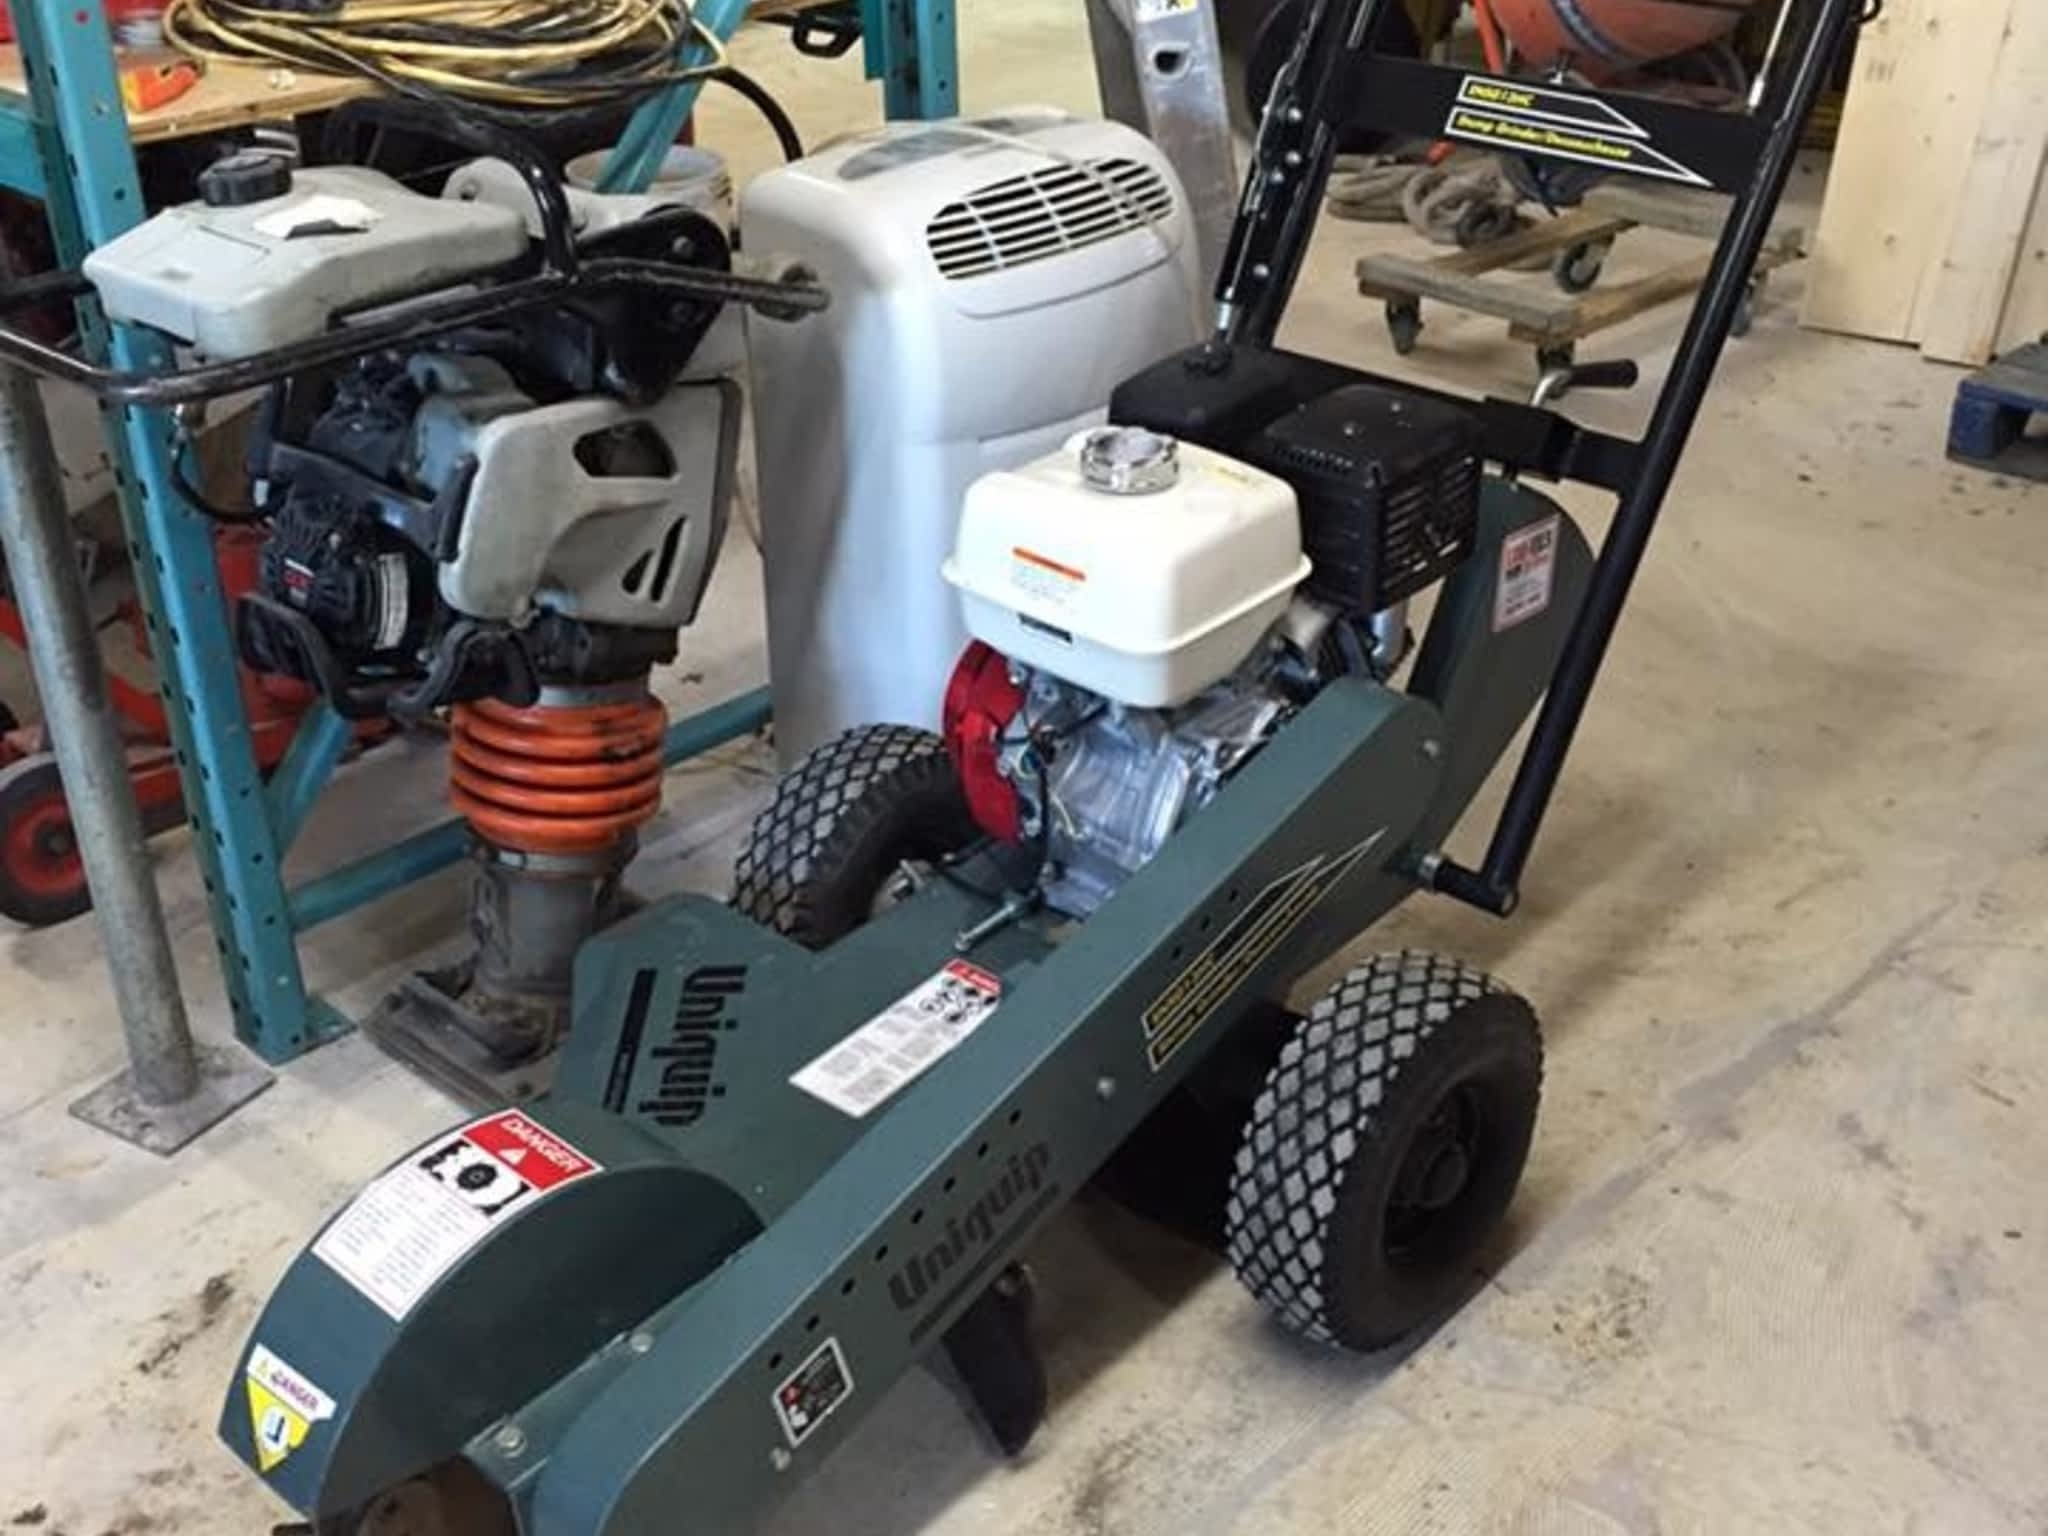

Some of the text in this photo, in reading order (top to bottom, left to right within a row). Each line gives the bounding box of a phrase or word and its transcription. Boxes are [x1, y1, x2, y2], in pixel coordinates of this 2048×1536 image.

[638, 964, 749, 1127] Uniquip
[501, 1115, 584, 1173] DANGER
[887, 1141, 1051, 1311] Uniquip
